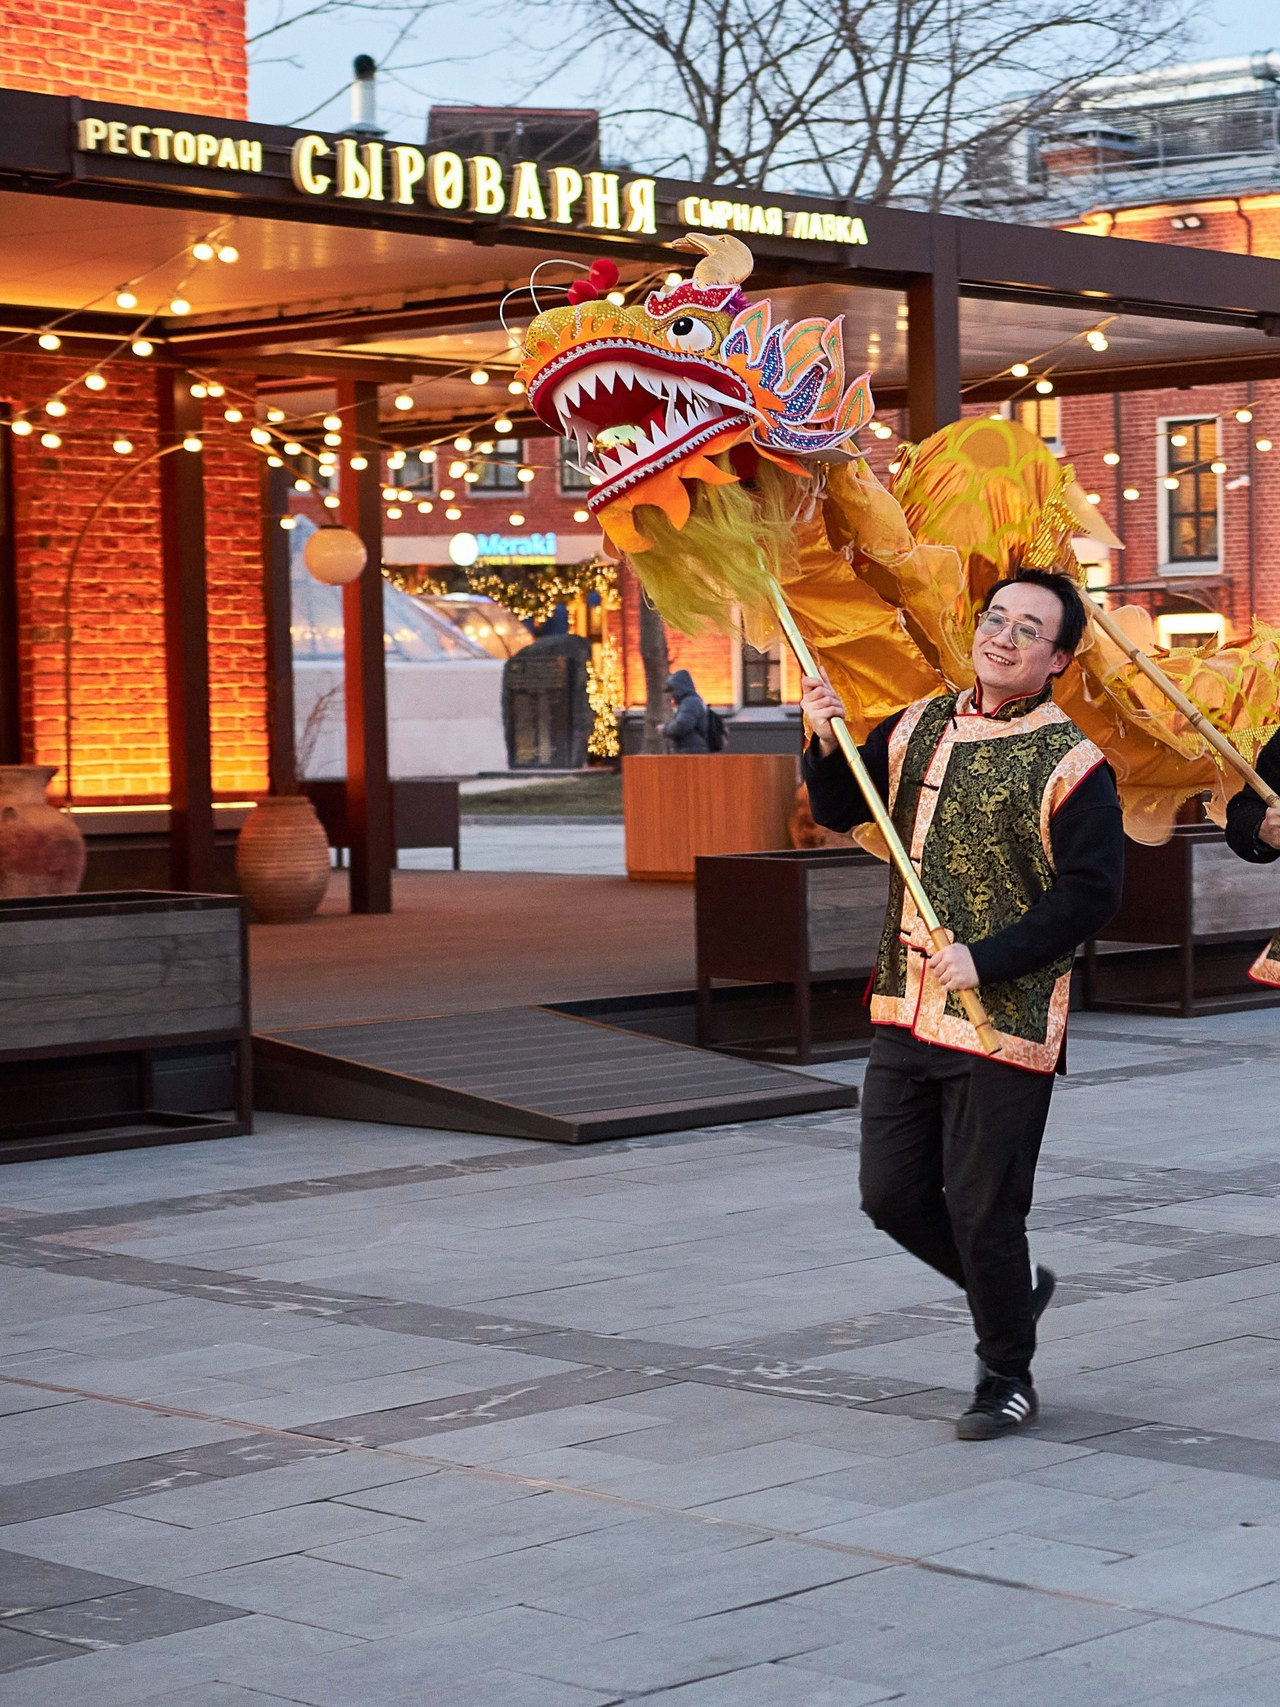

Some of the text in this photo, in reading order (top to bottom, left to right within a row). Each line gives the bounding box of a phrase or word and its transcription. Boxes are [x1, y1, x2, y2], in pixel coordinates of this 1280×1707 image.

[82, 117, 262, 173] РЕСТОРАН
[295, 134, 657, 235] СЫРОВАРНЯ
[683, 196, 869, 245] СЫРНАЯ ЛАВКА
[476, 532, 557, 556] Meraki
